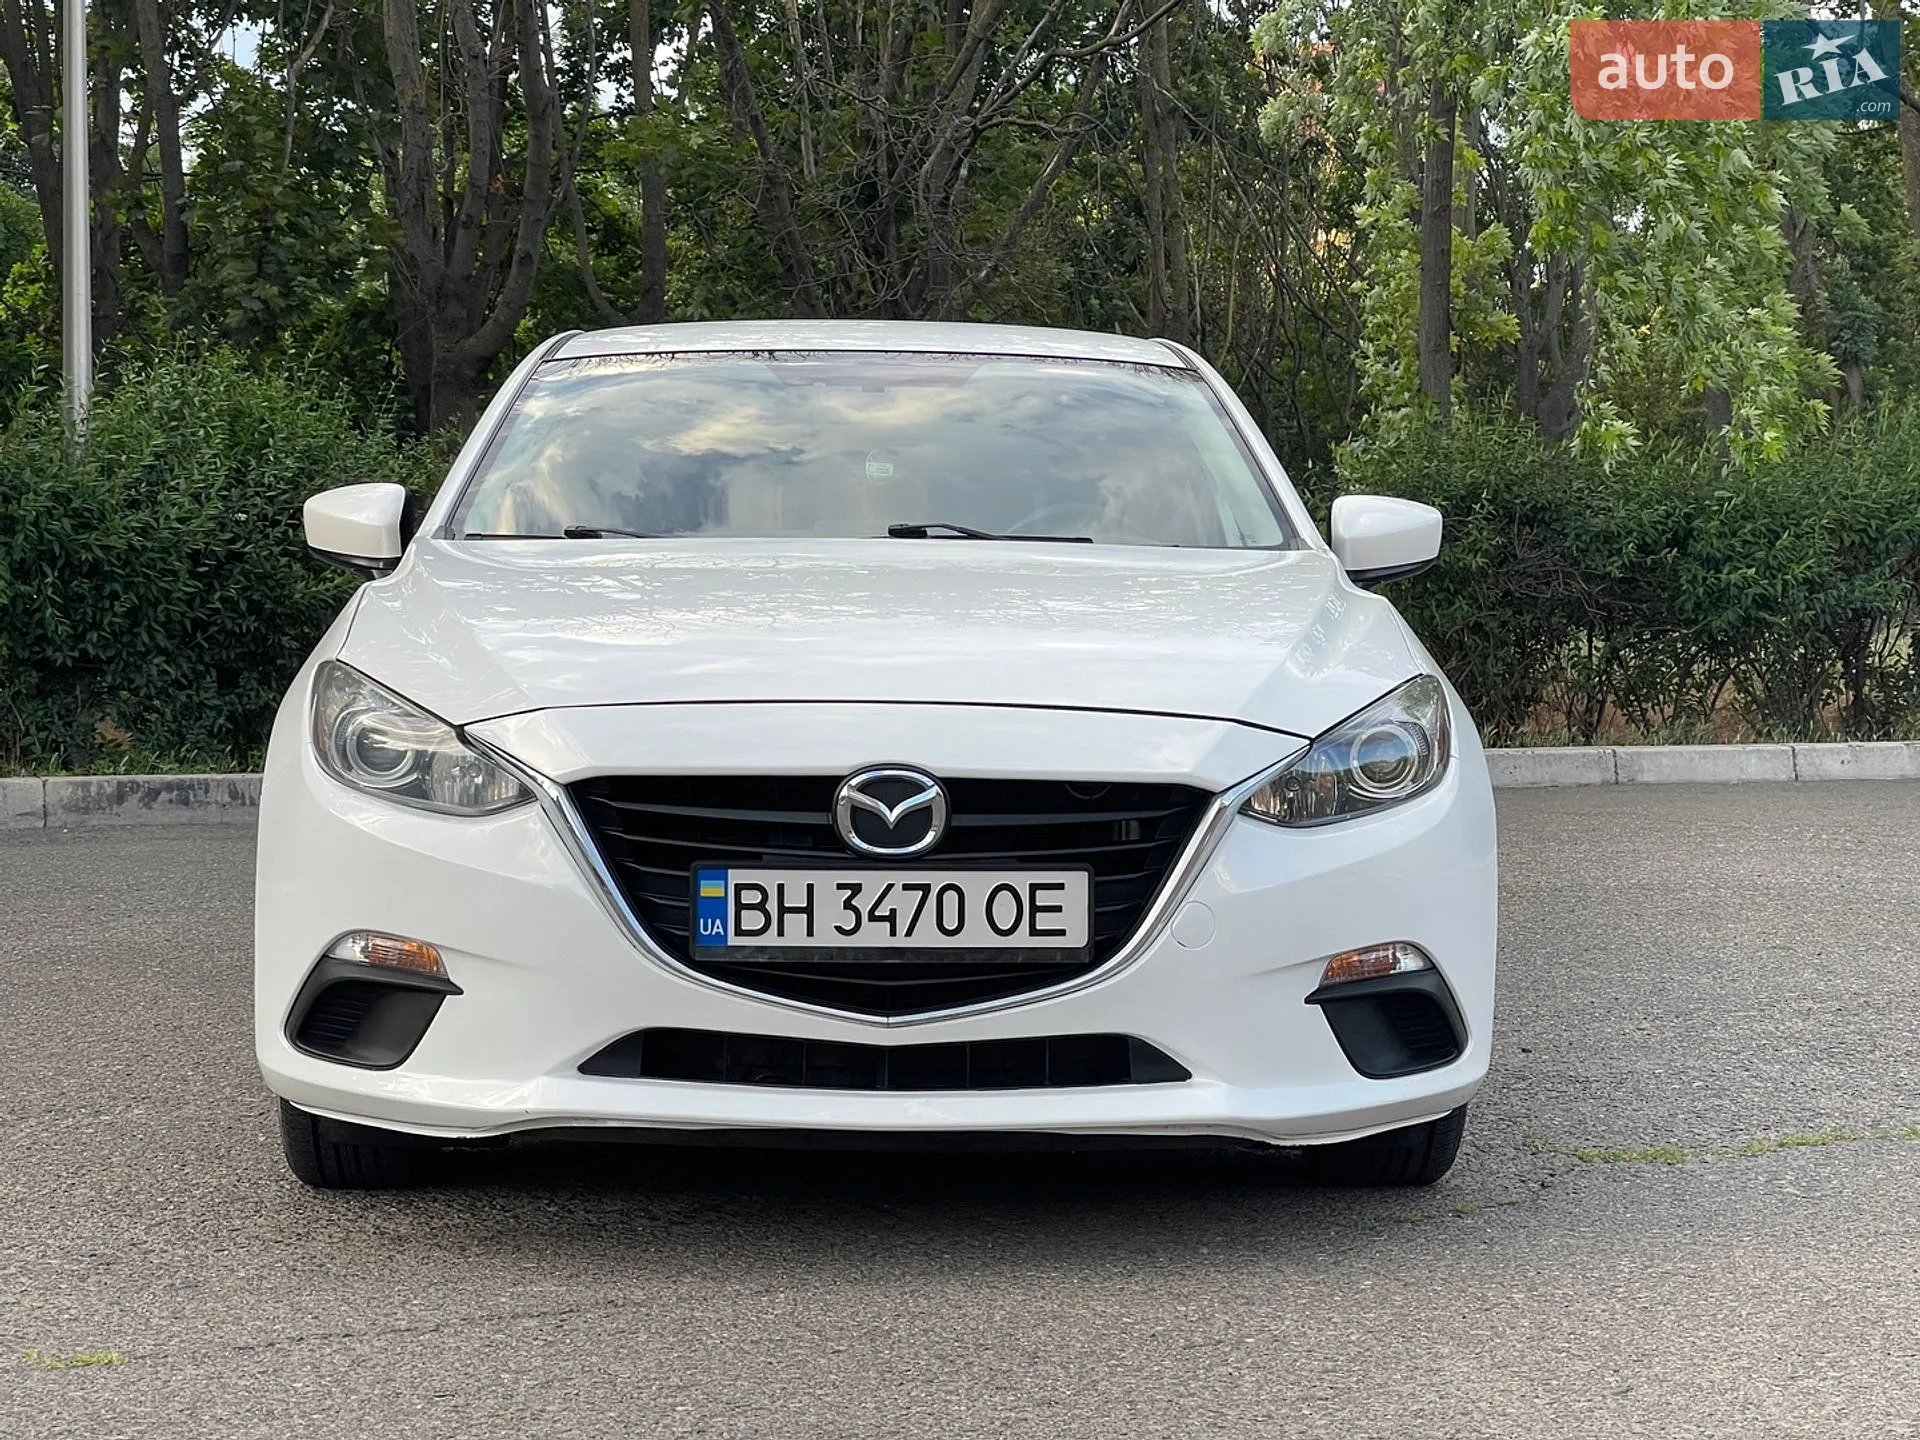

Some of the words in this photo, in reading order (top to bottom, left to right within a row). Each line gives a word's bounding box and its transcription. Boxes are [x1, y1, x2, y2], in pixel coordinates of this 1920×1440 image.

[699, 918, 725, 936] UA
[733, 882, 815, 938] BH
[833, 882, 966, 938] 3470
[985, 882, 1067, 938] OE
